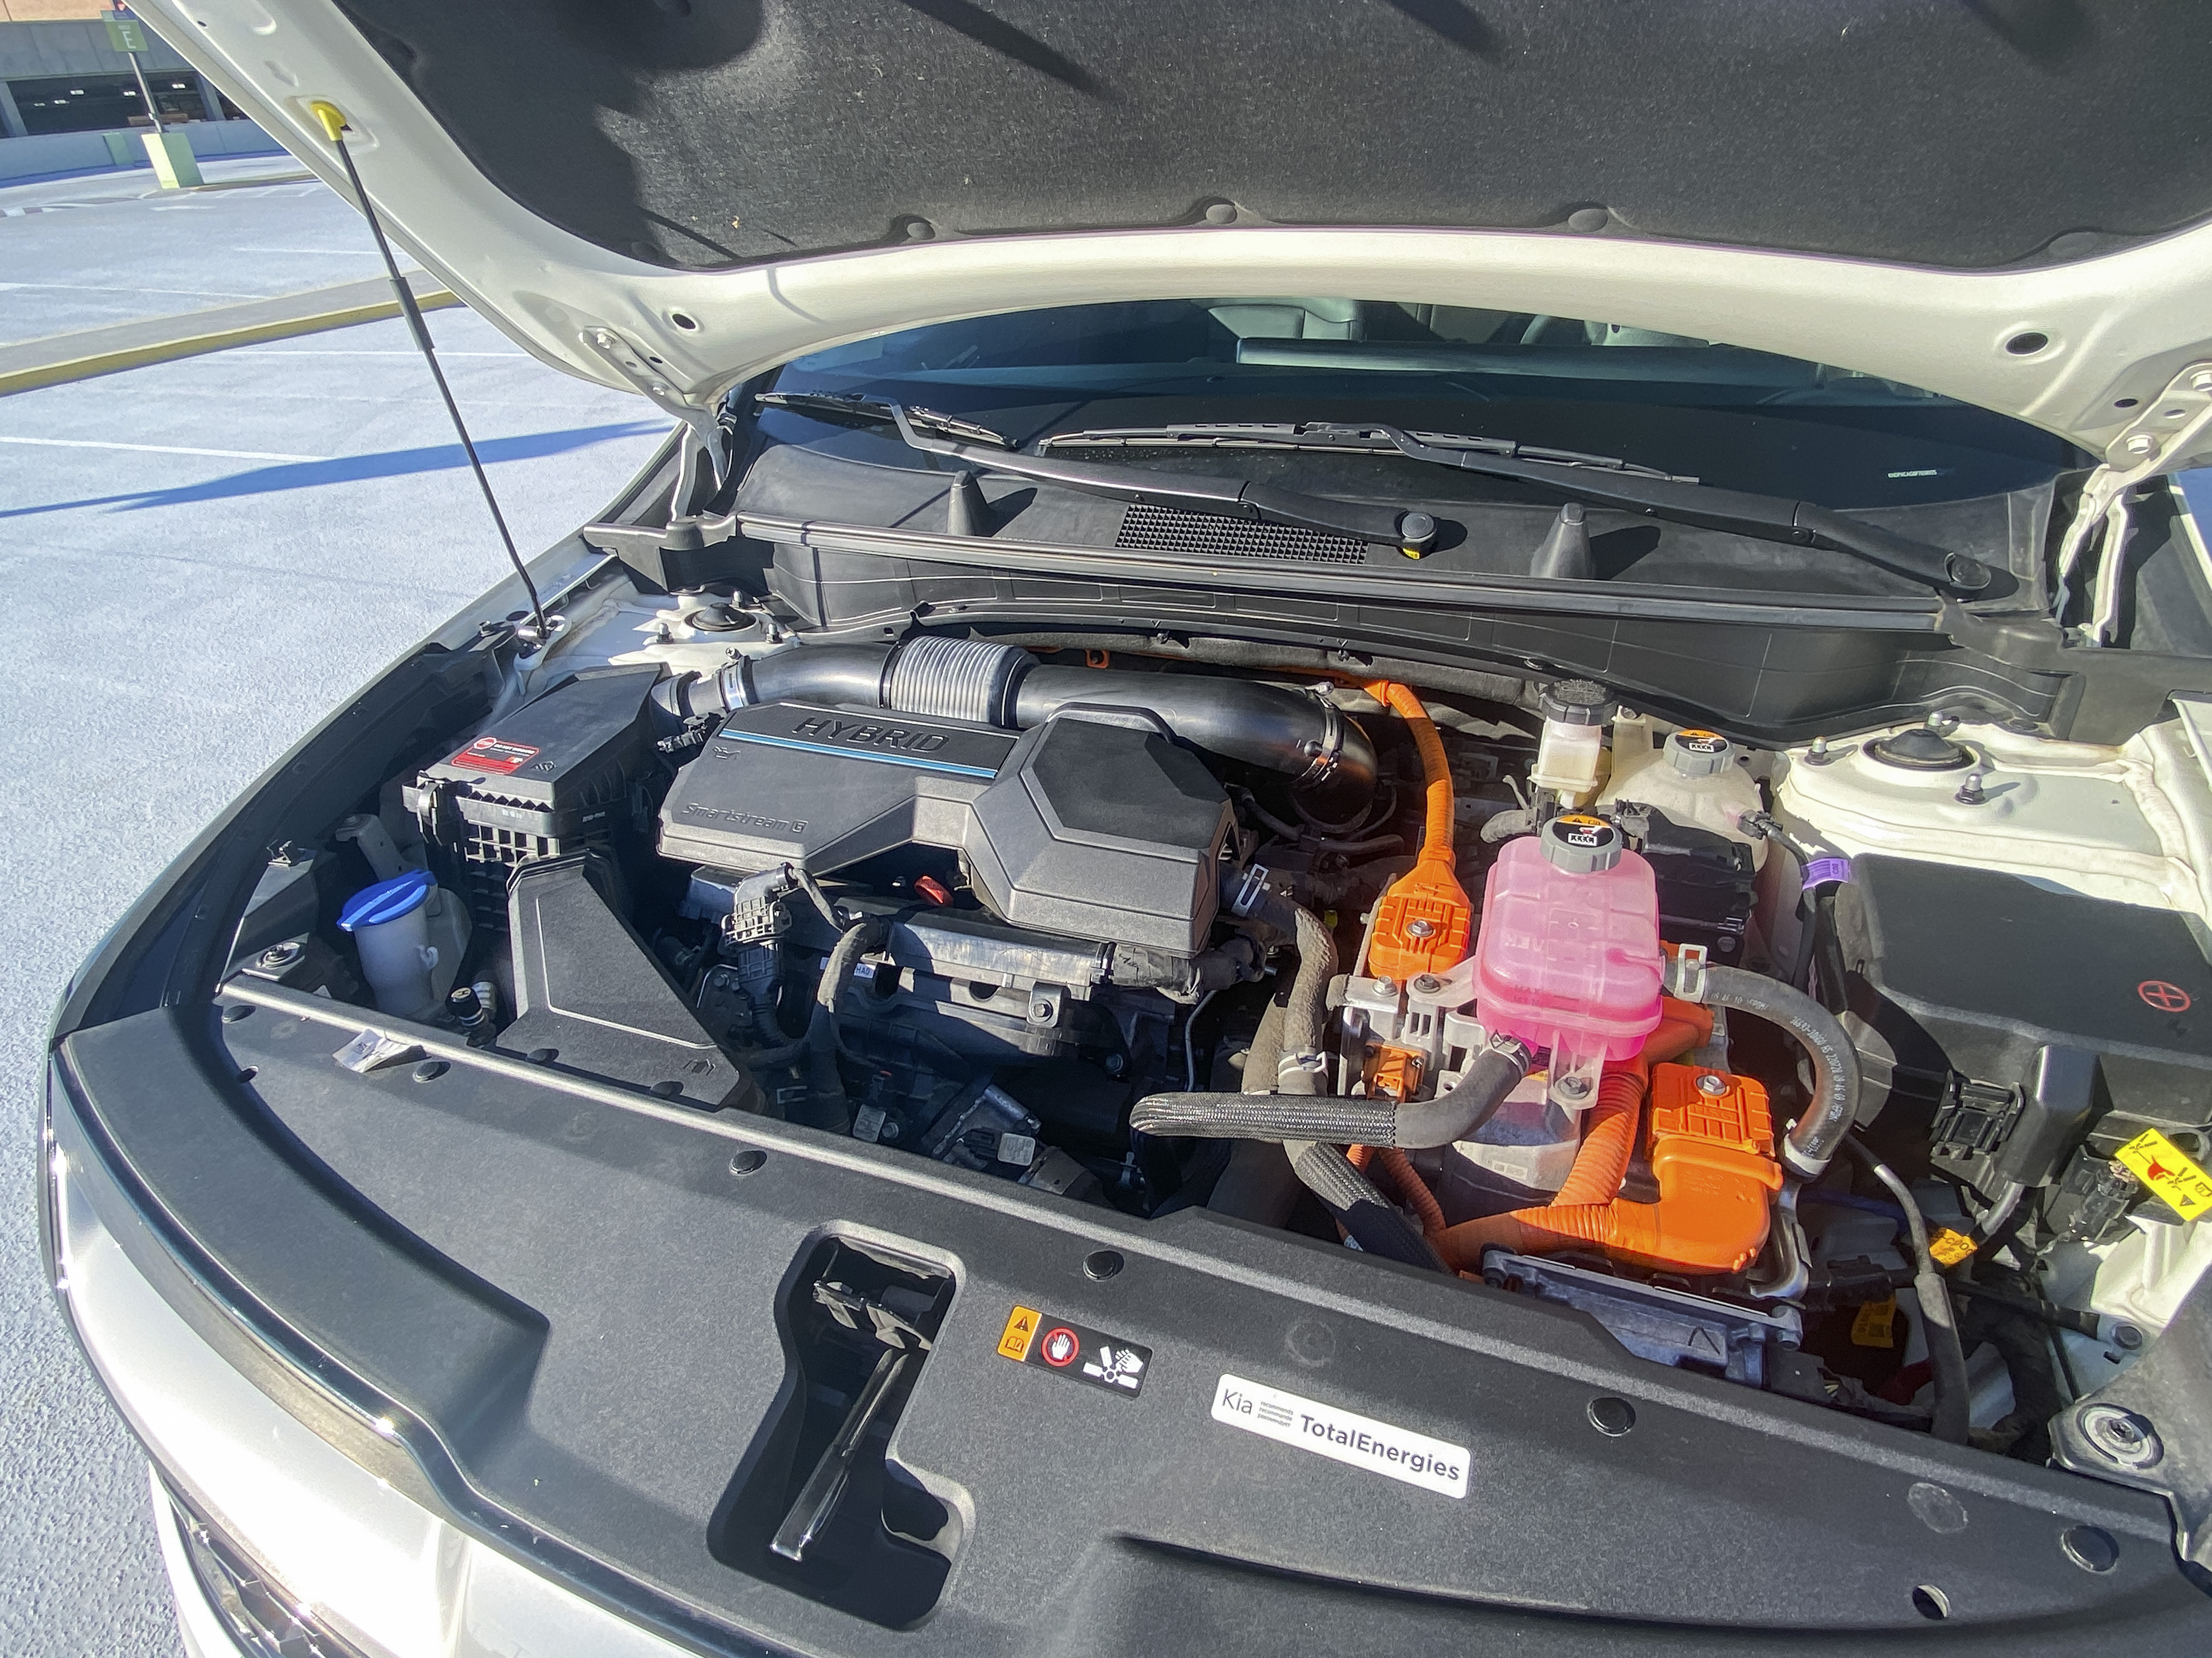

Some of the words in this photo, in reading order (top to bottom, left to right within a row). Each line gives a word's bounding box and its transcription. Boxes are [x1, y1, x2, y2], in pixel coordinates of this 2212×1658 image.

[121, 31, 137, 49] E
[792, 717, 949, 752] HYBRID
[681, 802, 790, 830] Smartstream
[1222, 1388, 1253, 1415] Kia
[1300, 1413, 1460, 1480] TotalEnergies
